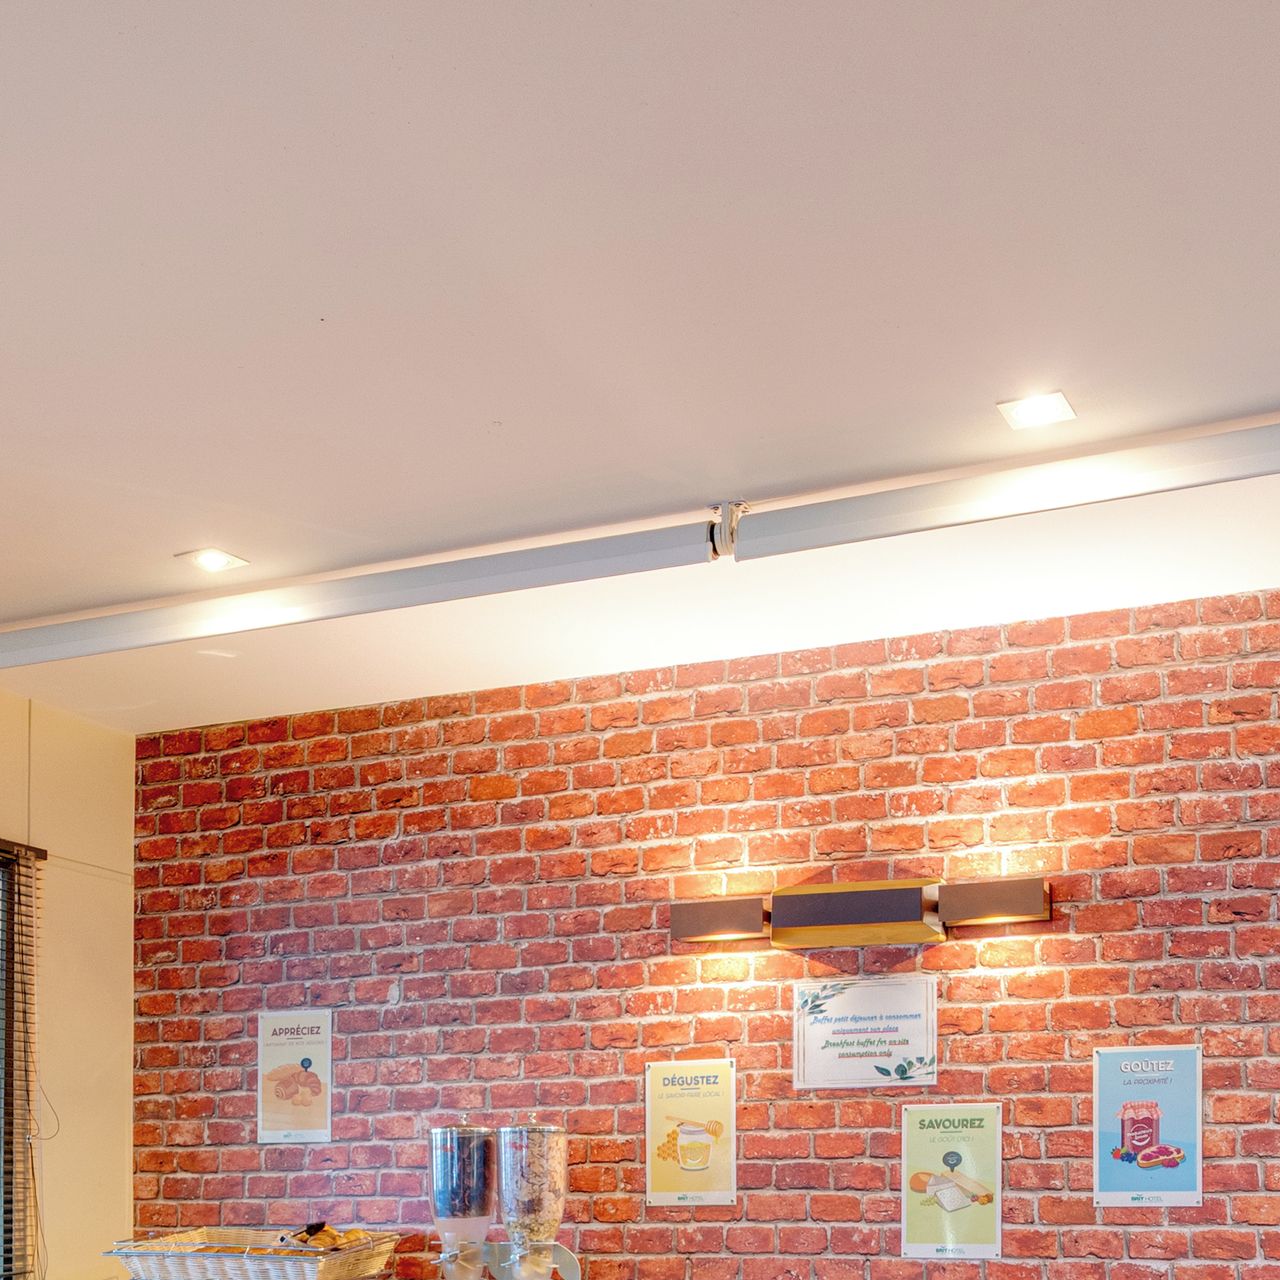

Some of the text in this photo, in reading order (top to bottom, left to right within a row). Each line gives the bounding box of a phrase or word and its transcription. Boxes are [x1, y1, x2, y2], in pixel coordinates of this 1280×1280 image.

[834, 1016, 849, 1024] petit
[272, 1024, 320, 1037] APPRÉCIEZ
[882, 1025, 898, 1033] place
[821, 1039, 855, 1049] Breakfast
[856, 1039, 876, 1048] buffet
[838, 1049, 892, 1058] consumption only
[1120, 1059, 1174, 1073] GOÛTEZ
[662, 1074, 719, 1087] DÉGUSTEZ
[919, 1117, 984, 1130] SAVOUREZ
